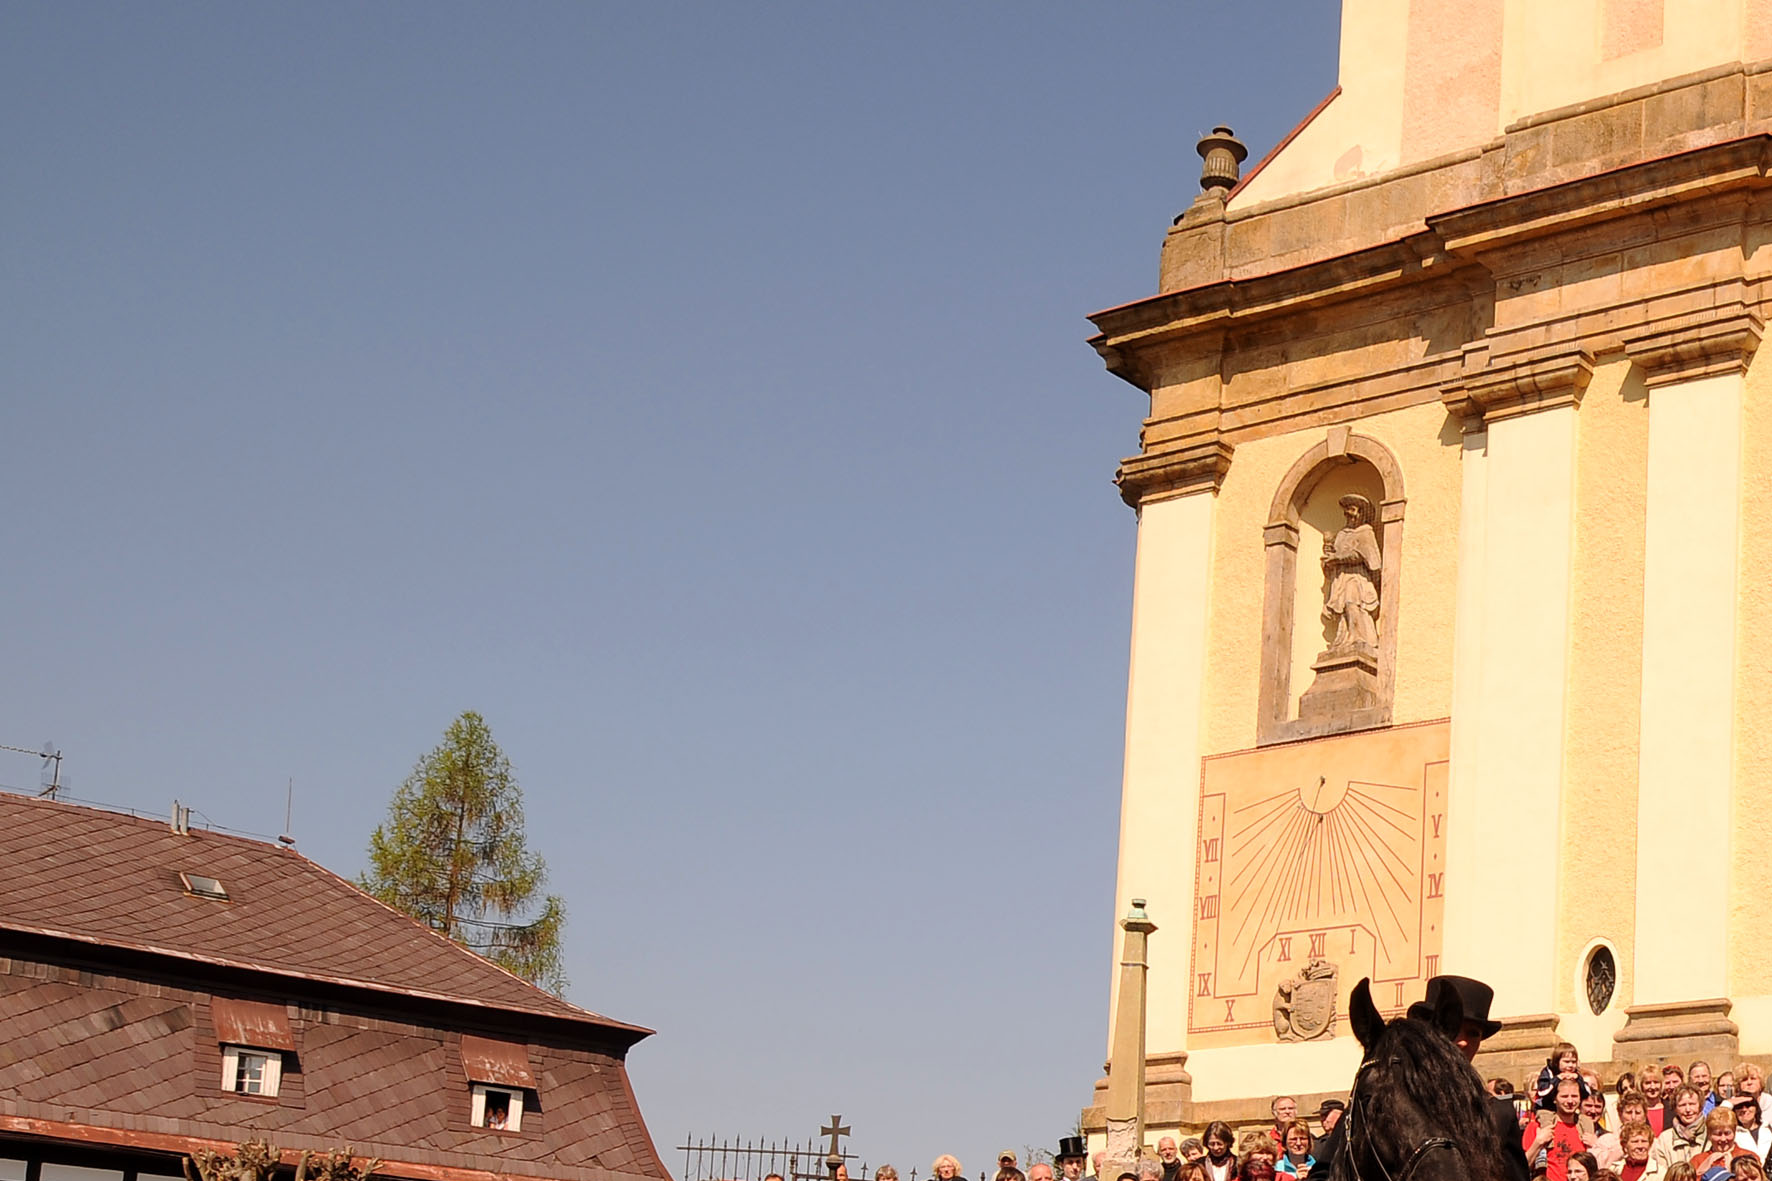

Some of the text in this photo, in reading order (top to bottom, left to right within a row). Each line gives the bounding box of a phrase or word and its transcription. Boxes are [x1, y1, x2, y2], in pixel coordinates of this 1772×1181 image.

[1431, 813, 1442, 838] V
[1203, 838, 1219, 863] VII
[1426, 872, 1444, 899] IV
[1200, 894, 1218, 920] VIII
[1277, 928, 1356, 962] XI XII I
[1424, 955, 1439, 982] III
[1197, 972, 1212, 997] IX
[1394, 982, 1404, 1008] II
[1224, 999, 1235, 1022] X
